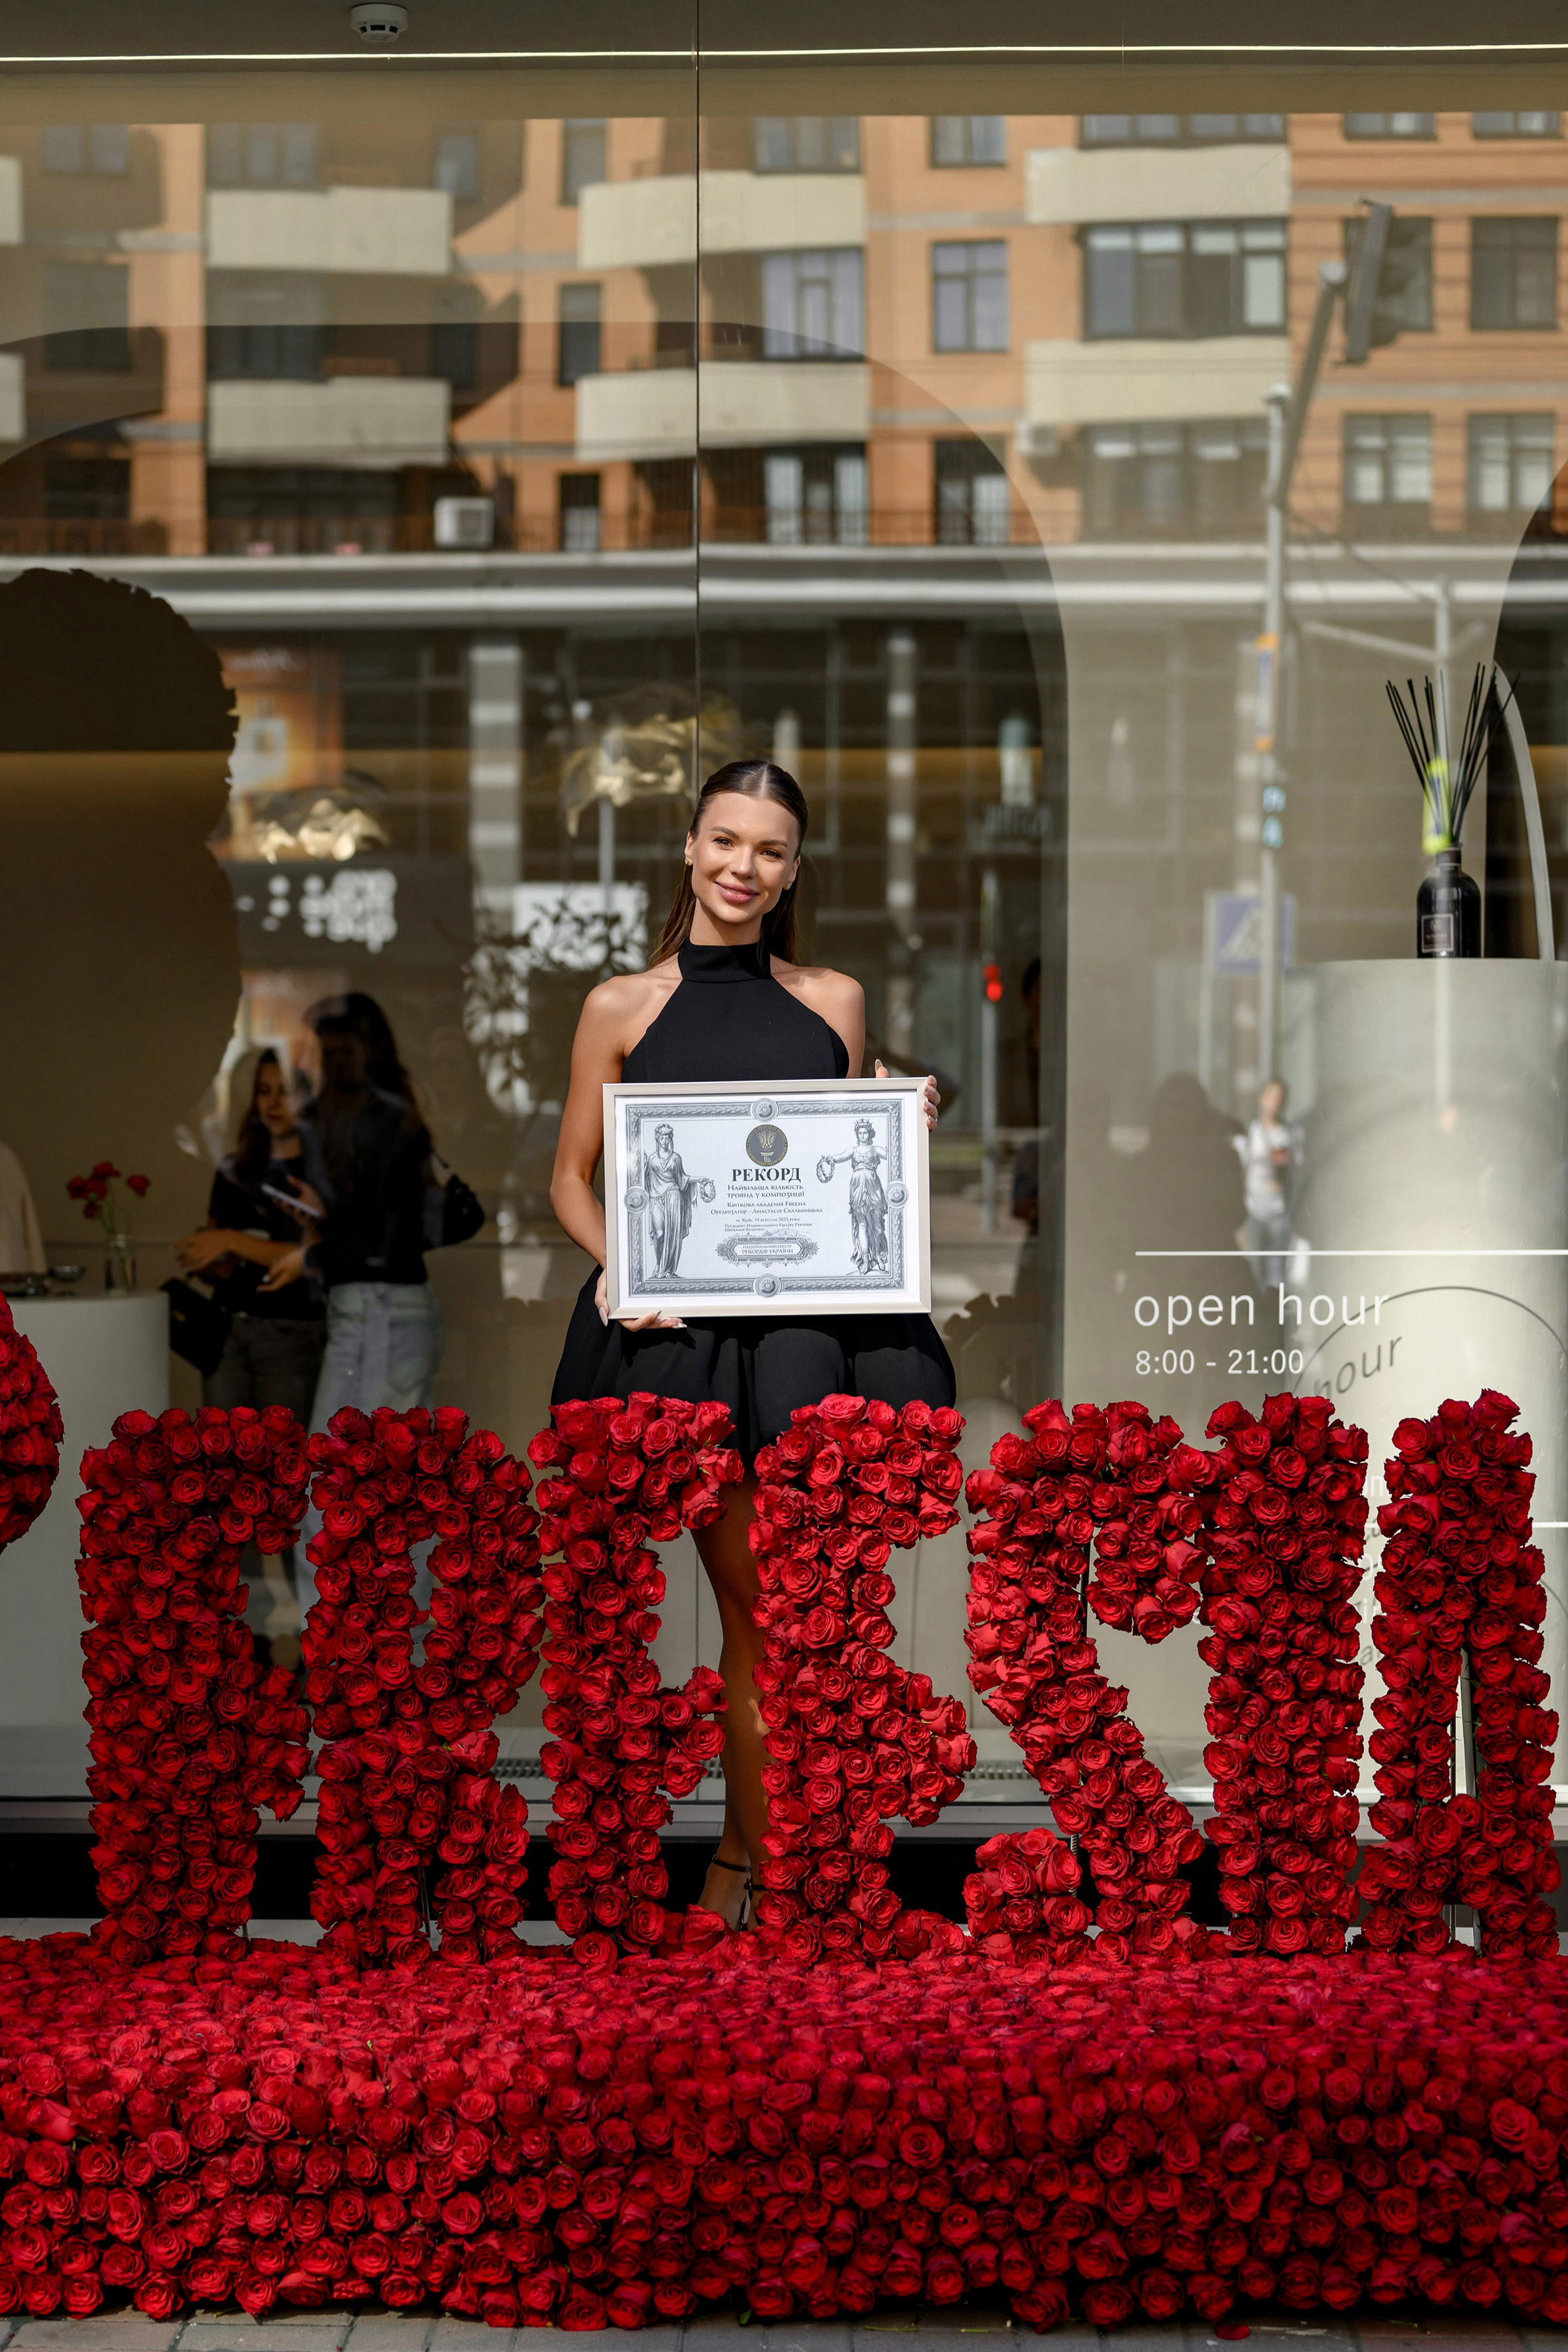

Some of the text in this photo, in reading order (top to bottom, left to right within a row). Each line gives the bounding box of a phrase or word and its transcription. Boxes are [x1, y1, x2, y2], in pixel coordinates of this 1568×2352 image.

[732, 1168, 801, 1183] РЕКОРД
[1134, 1282, 1389, 1335] open hour
[1135, 1350, 1194, 1375] 8:00
[1228, 1349, 1304, 1374] 21:00
